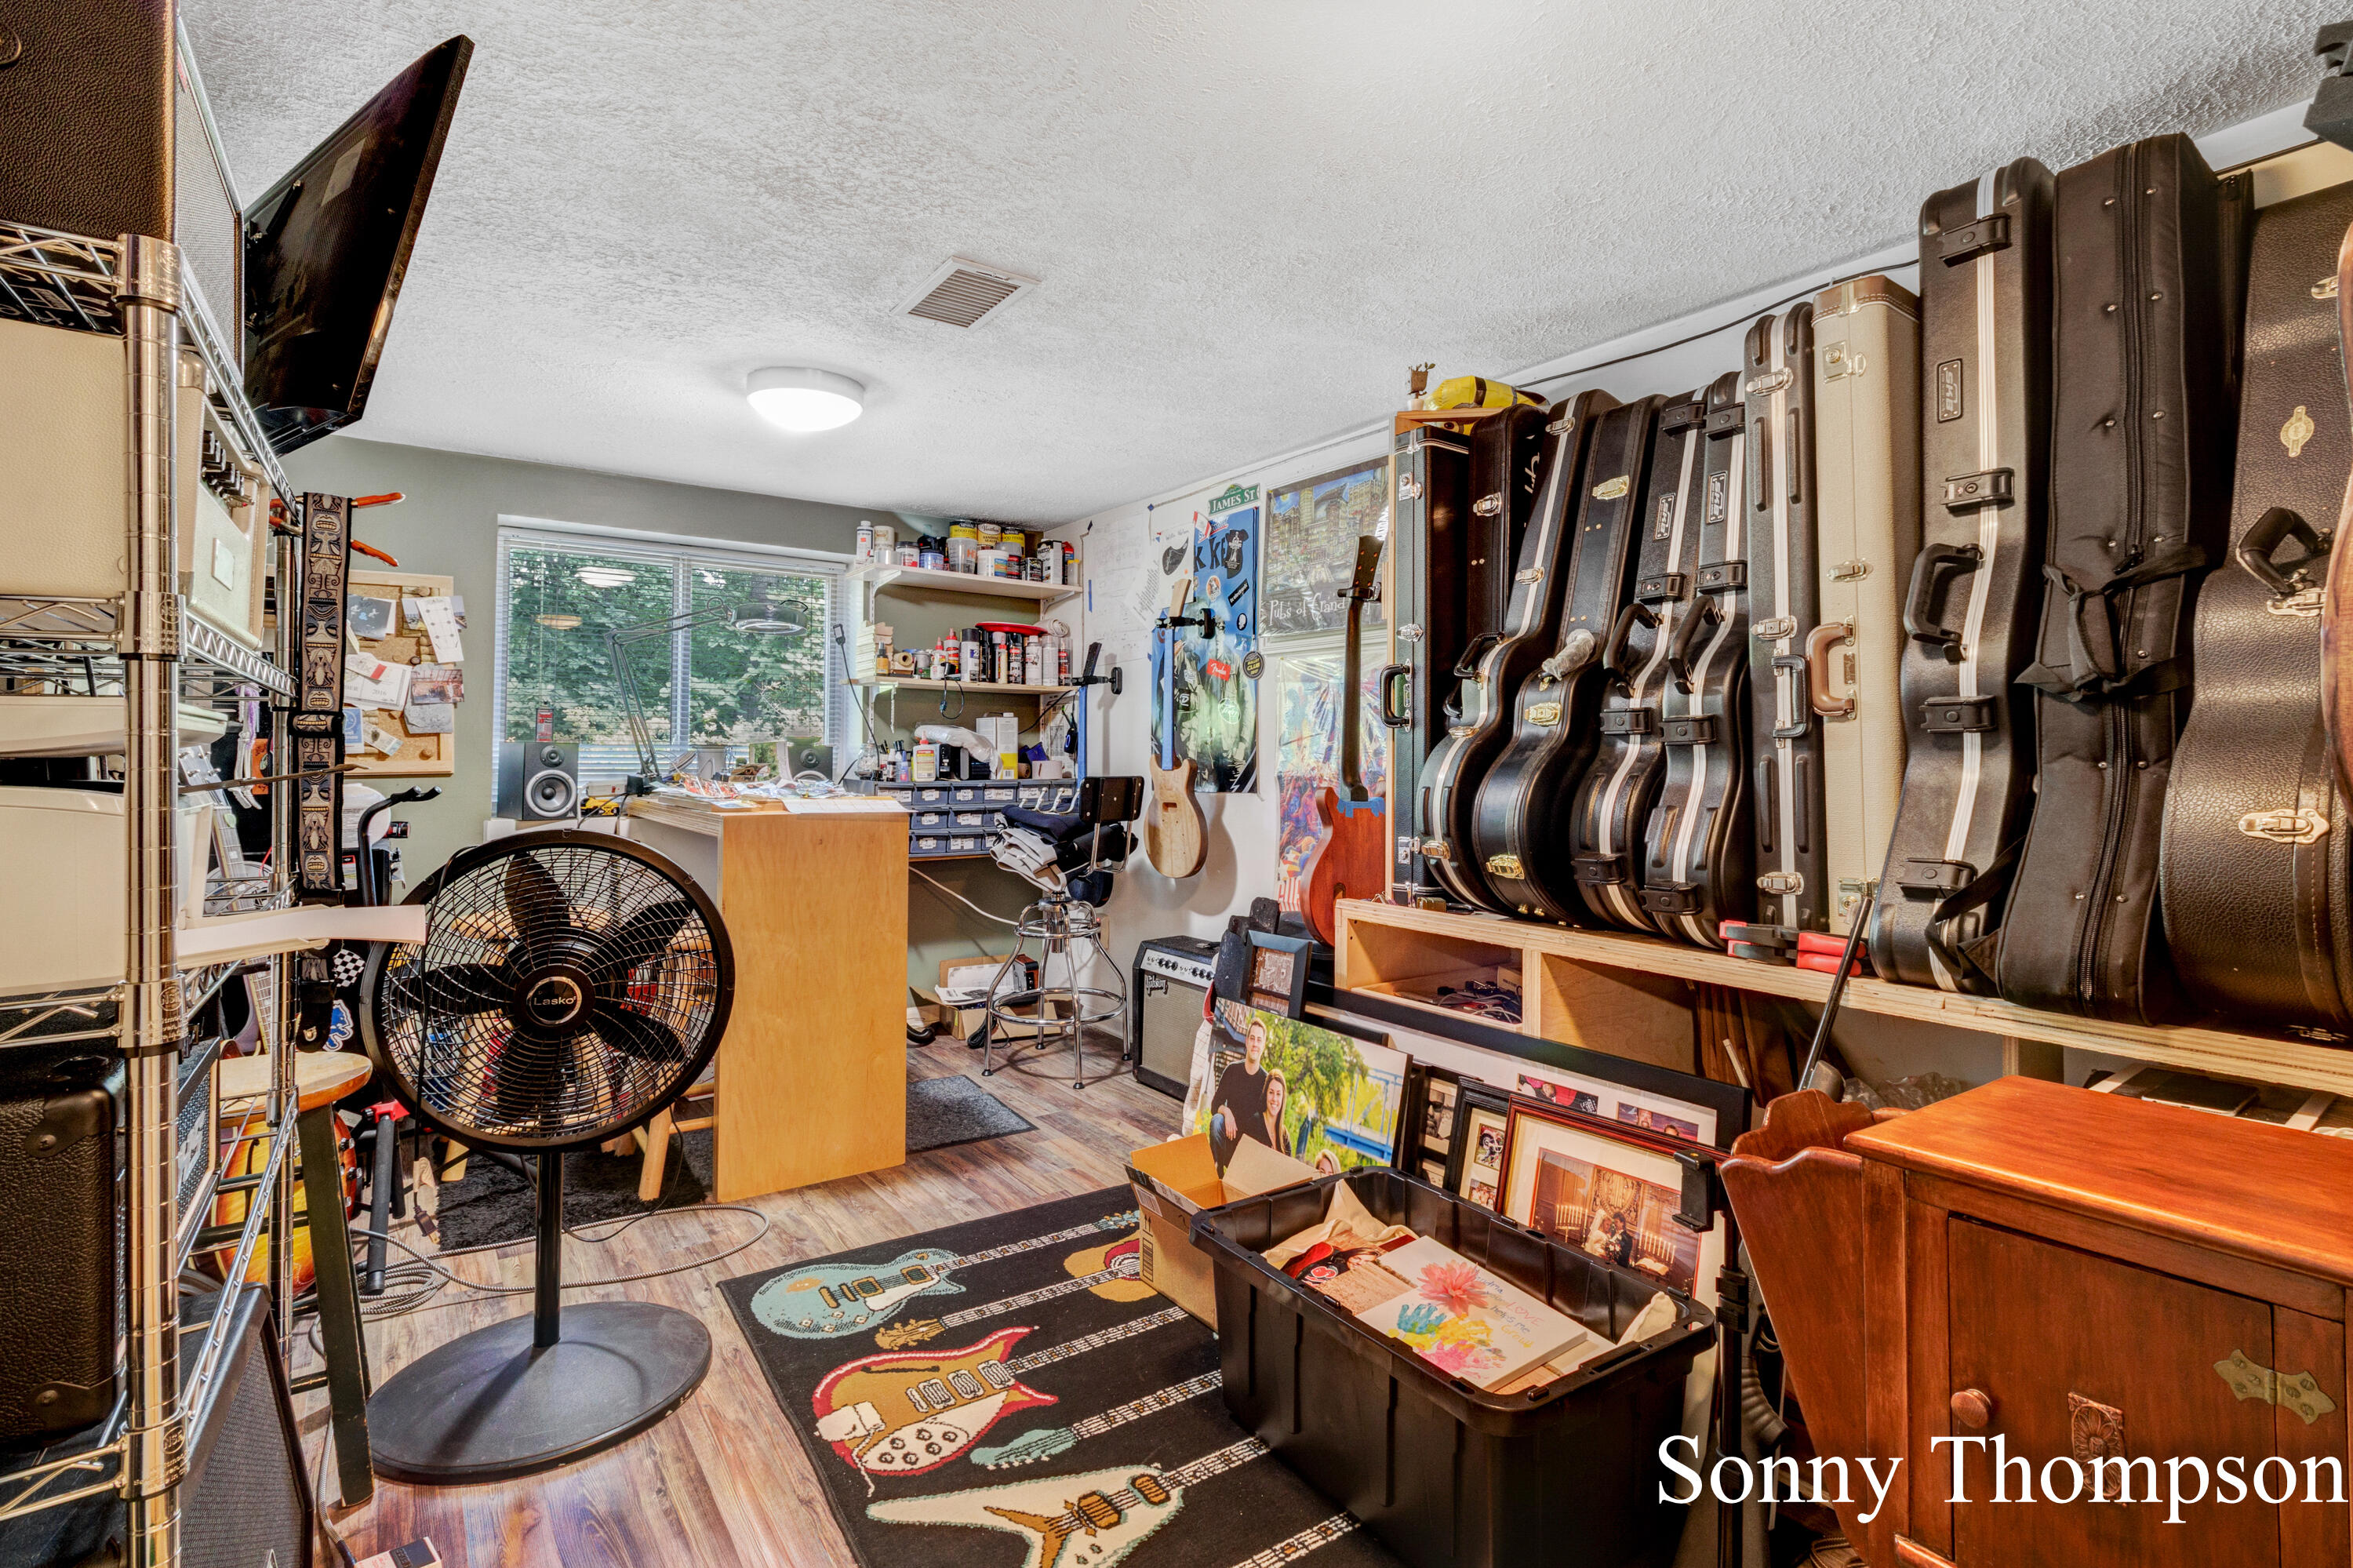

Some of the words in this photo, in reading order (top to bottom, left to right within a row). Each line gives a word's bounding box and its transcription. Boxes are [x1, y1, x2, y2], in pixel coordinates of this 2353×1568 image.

[1211, 493, 1242, 513] JAMES
[1243, 489, 1255, 502] ST
[1268, 598, 1292, 626] Pubs
[1296, 596, 1307, 617] of
[1311, 591, 1346, 627] Grand
[1146, 975, 1167, 995] Gibson
[533, 996, 574, 1006] Lasko
